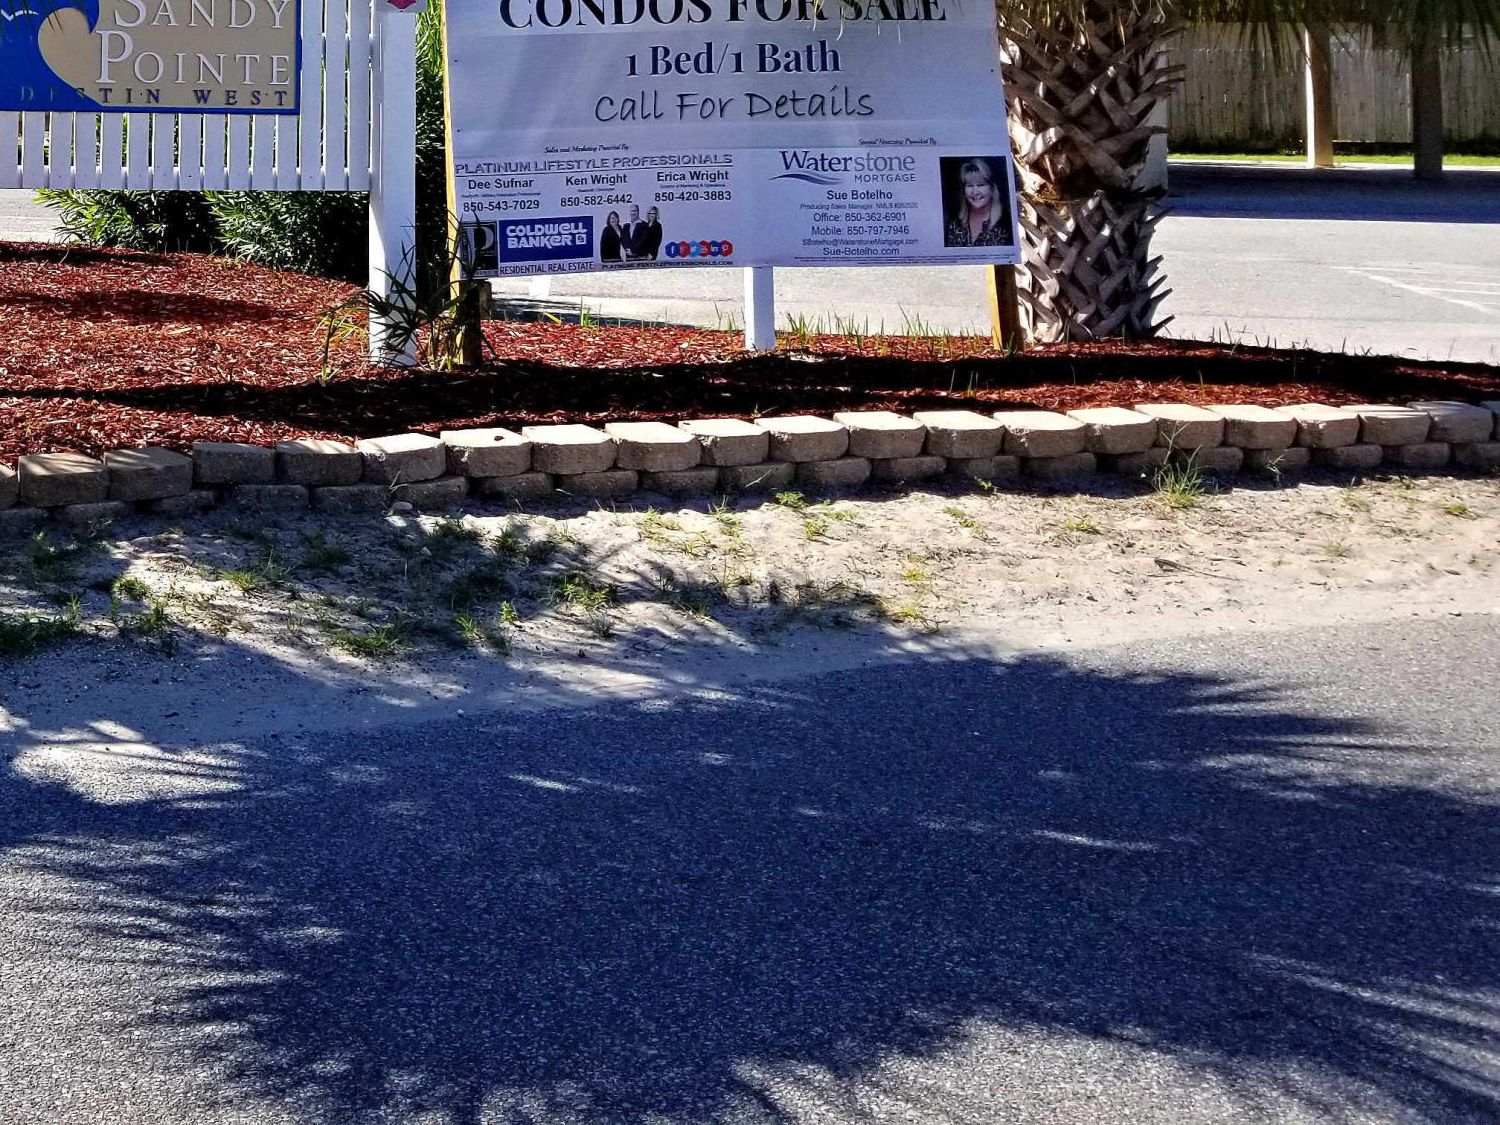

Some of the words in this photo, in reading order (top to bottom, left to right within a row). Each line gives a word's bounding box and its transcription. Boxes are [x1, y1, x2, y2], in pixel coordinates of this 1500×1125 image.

[94, 29, 291, 85] POINTE
[626, 53, 638, 76] 1
[649, 42, 745, 75] Bed/1
[756, 39, 842, 74] Bath
[193, 89, 287, 105] WEST
[595, 90, 664, 122] Call
[675, 92, 735, 121] For
[744, 85, 875, 119] Details
[455, 161, 531, 174] PLATINUM
[534, 158, 609, 172] LIFESTYLE
[612, 154, 733, 168] PROFESSIONALS
[779, 150, 916, 172] Waterstone
[566, 176, 587, 186] Ken
[590, 173, 627, 186] Wright
[657, 171, 685, 182] Erica
[689, 170, 729, 182] Wright
[854, 174, 916, 183] MORTGAGE
[468, 179, 491, 189] Dee
[494, 178, 534, 189] Sufnar
[560, 194, 632, 207] 850-582-6442
[654, 190, 732, 202] 850-420-3883
[826, 189, 848, 200] Sue
[851, 189, 893, 200] Botelho
[463, 199, 540, 212] 850-543-7029
[813, 213, 842, 222] Office:
[845, 212, 907, 222] 850-362-6901
[811, 226, 844, 236] Mobile:
[823, 247, 900, 256] Sue-Botelho.com
[500, 264, 546, 275] RESIDENTIAL
[548, 263, 566, 273] REAL
[568, 261, 594, 272] ESTATE
